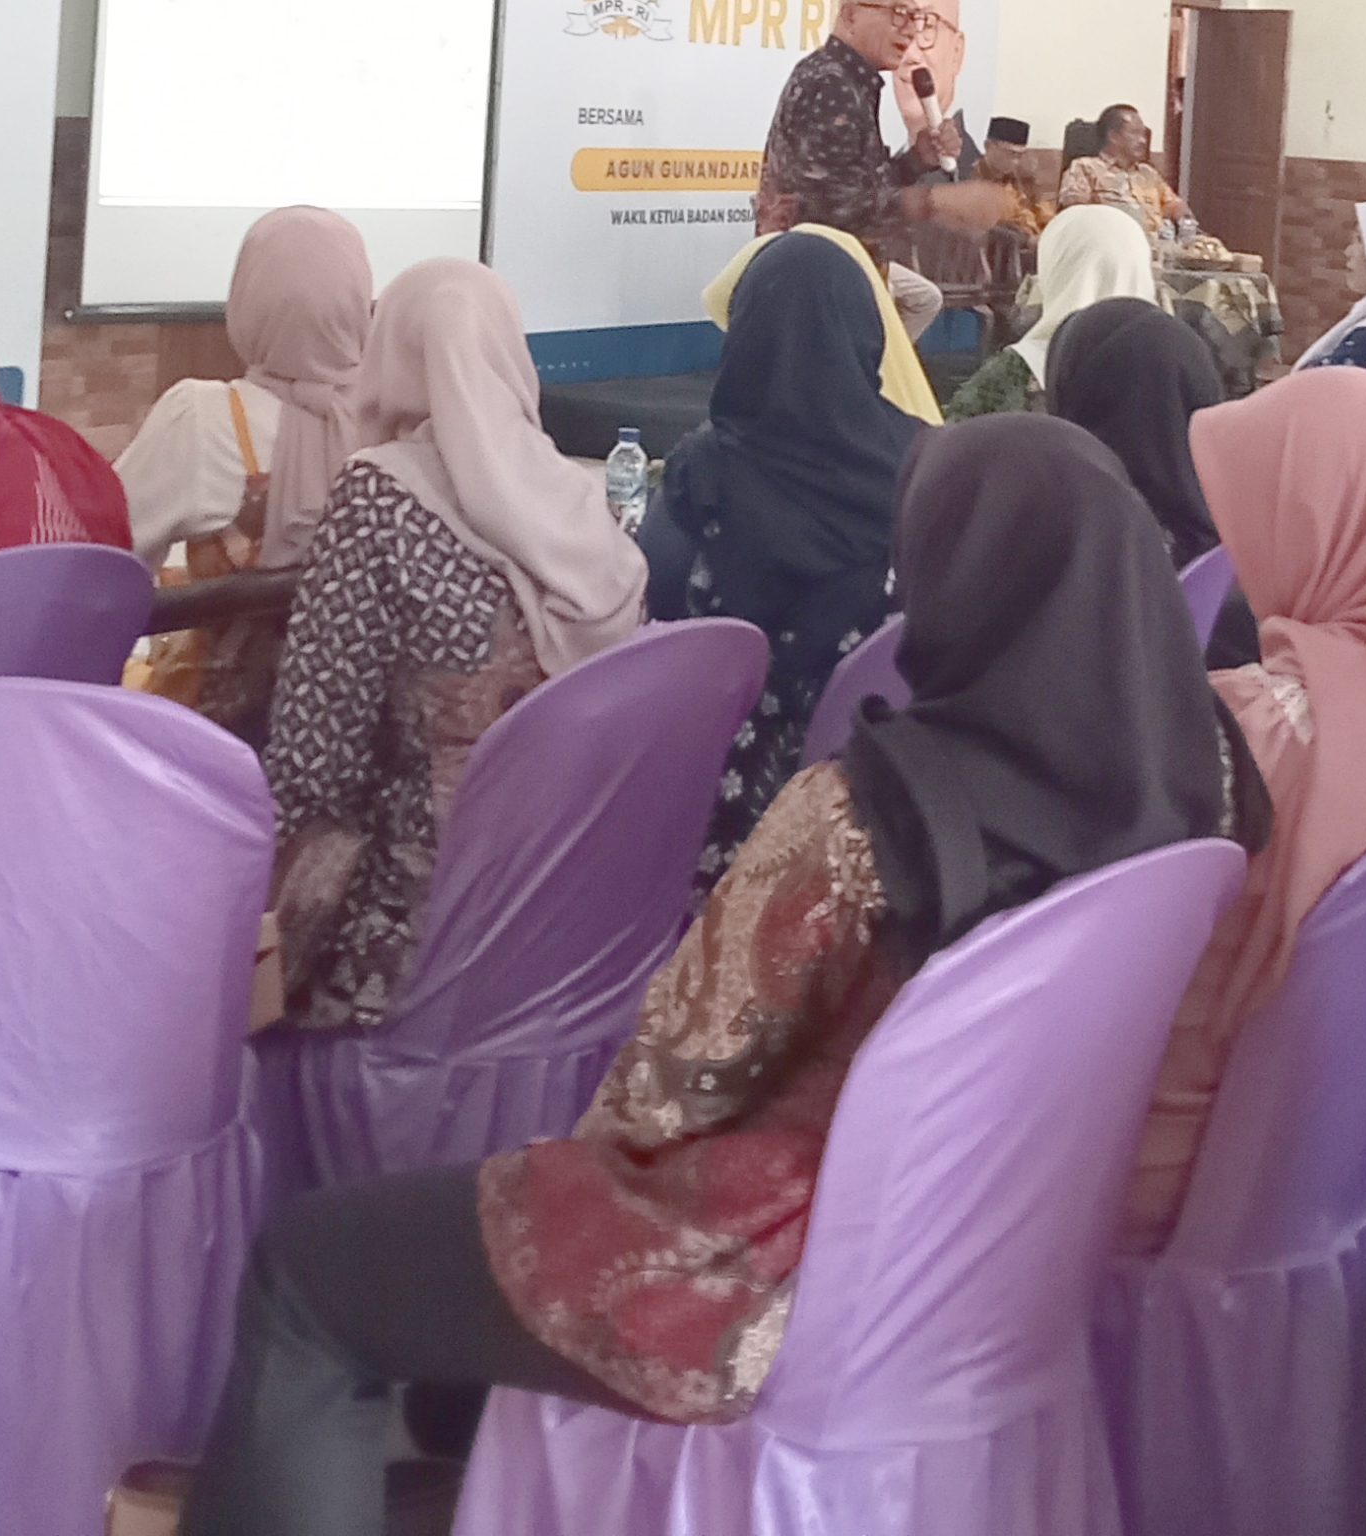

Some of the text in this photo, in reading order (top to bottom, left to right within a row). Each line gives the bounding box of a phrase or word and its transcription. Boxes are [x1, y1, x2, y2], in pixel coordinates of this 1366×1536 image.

[578, 106, 645, 126] BERSAMA
[605, 159, 761, 180] AGUN GUNANDJAR
[609, 208, 647, 226] WAKIL
[649, 208, 685, 225] KETUA
[686, 207, 726, 225] BADAN
